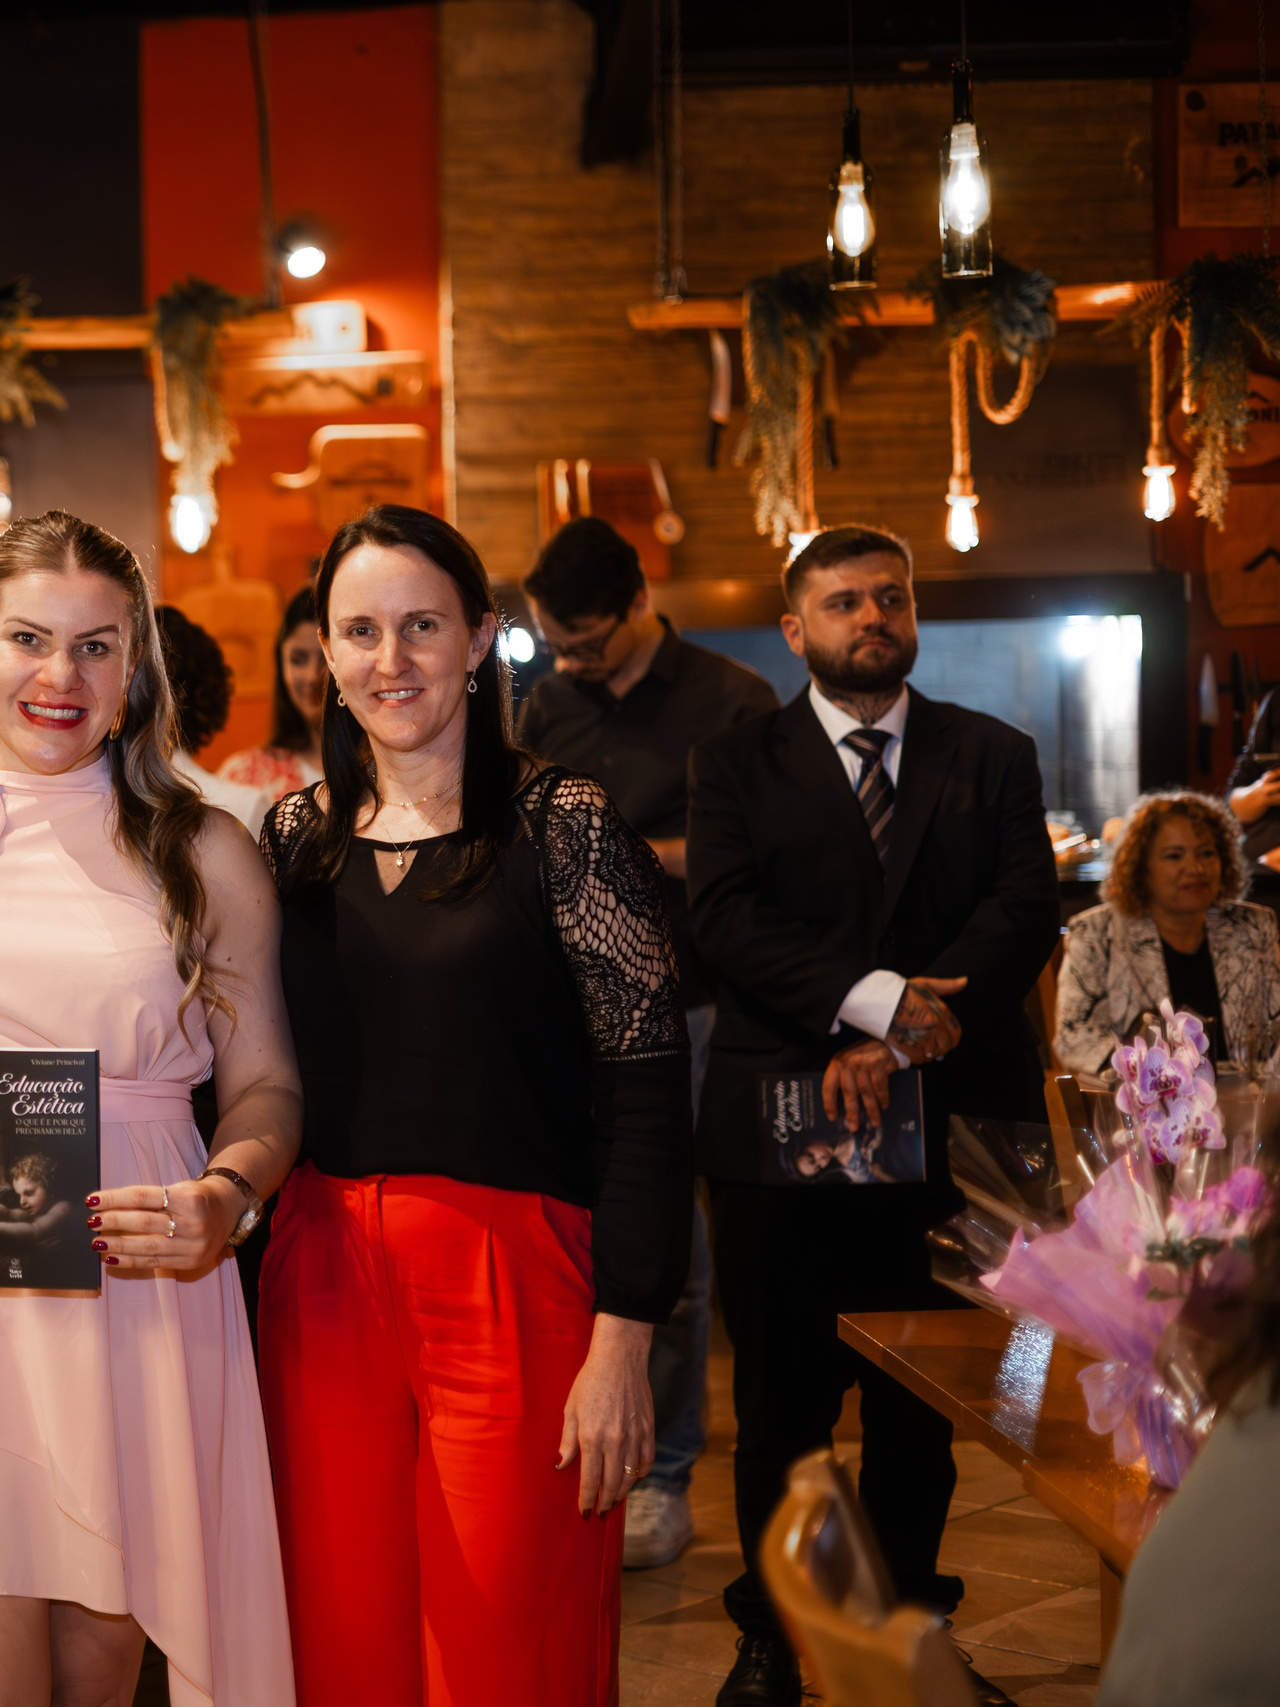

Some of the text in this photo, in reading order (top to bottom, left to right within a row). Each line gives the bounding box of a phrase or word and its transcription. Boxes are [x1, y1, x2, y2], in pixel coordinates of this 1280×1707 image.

[1218, 122, 1280, 146] PATA
[12, 1094, 85, 1116] Estética
[23, 1119, 39, 1127] QUE
[70, 1119, 86, 1127] QUE
